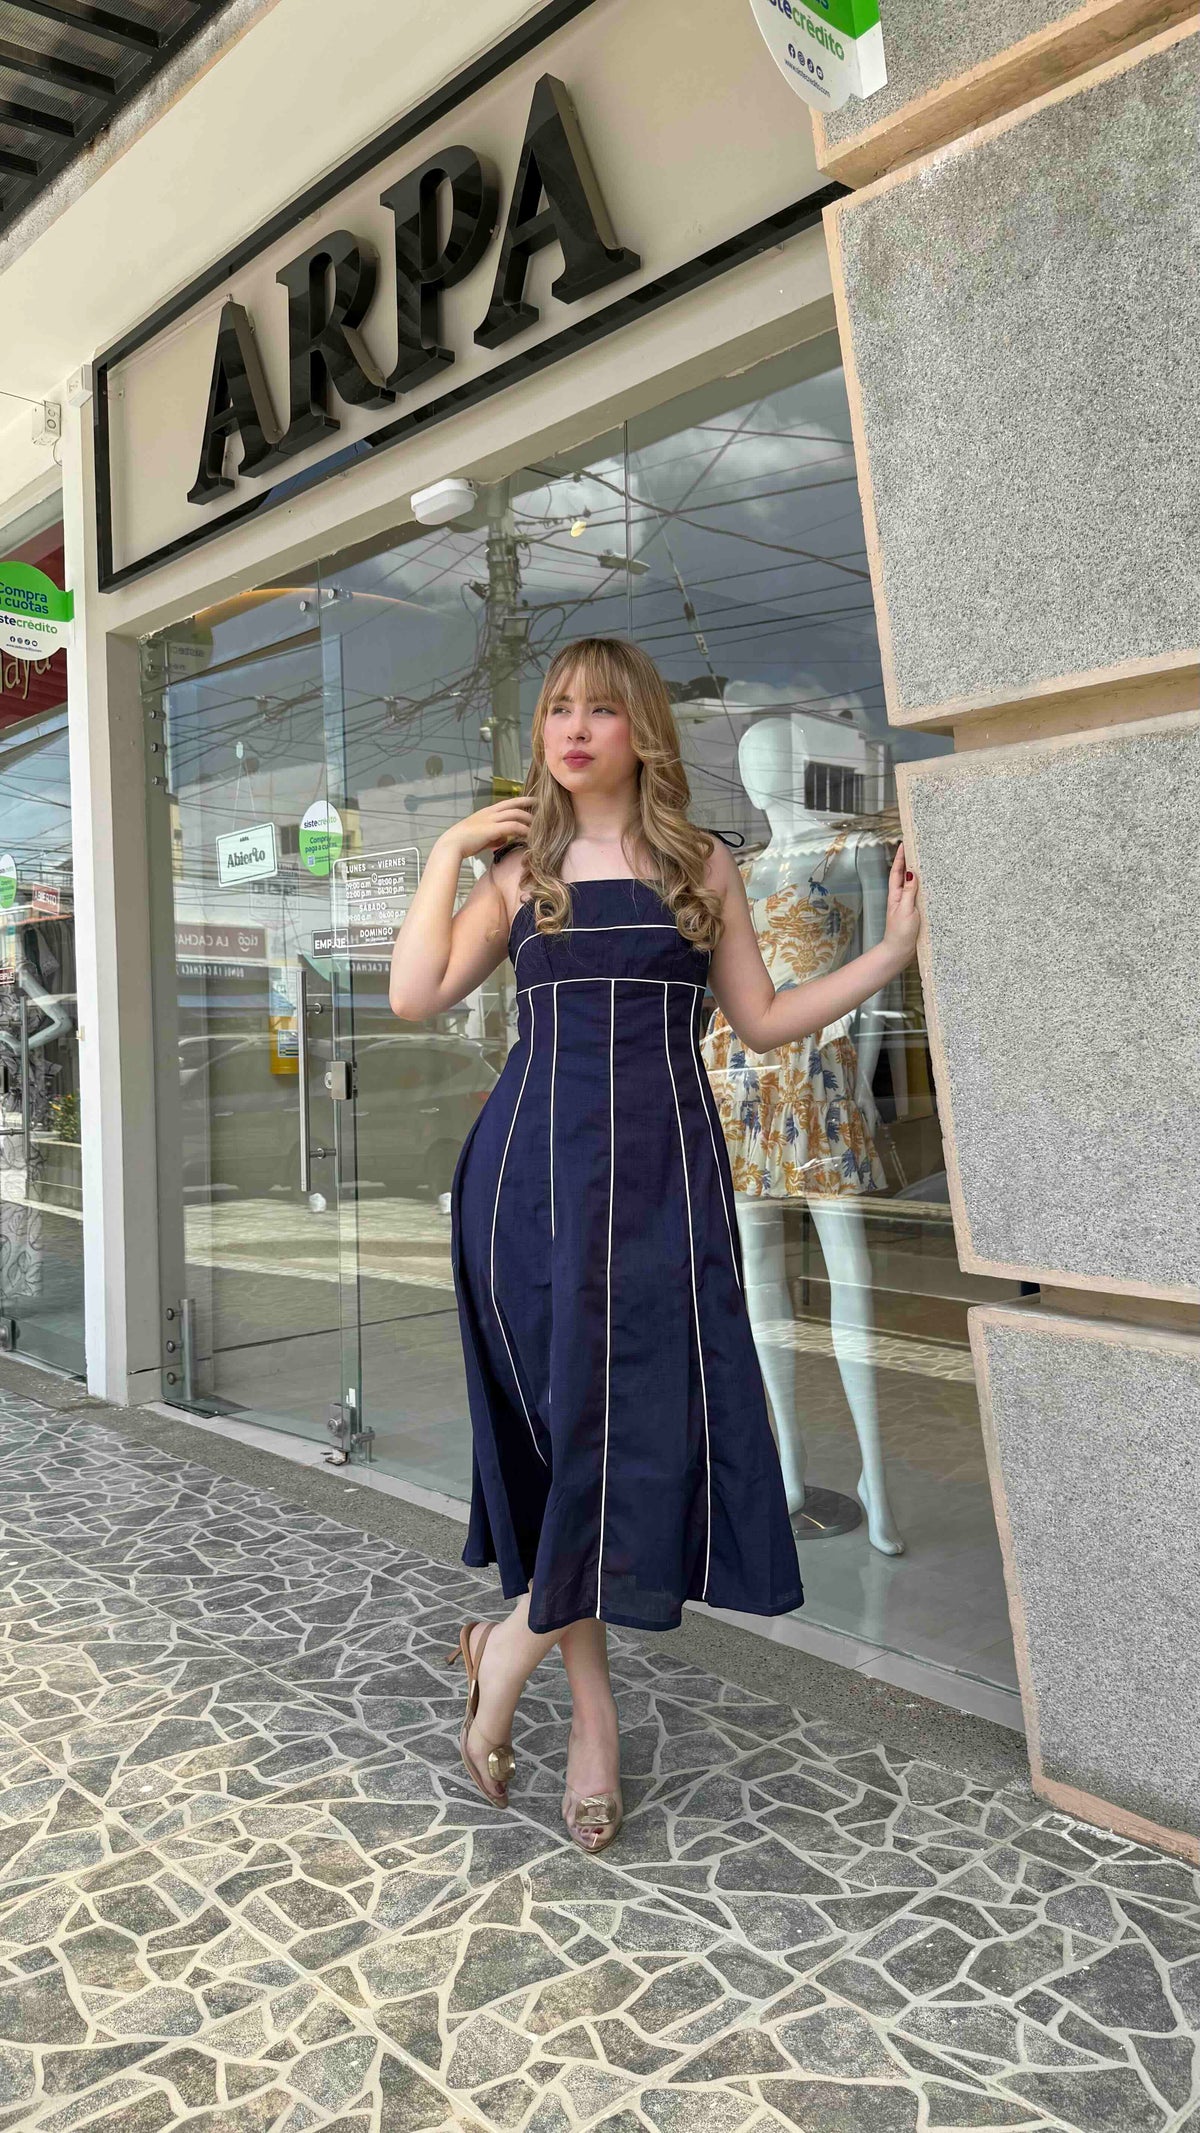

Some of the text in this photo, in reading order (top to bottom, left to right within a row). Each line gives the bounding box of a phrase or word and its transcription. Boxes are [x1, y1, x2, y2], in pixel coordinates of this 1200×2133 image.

[187, 73, 640, 505] ARPA
[0, 582, 47, 603] Compra
[5, 597, 49, 614] cuotas
[227, 847, 266, 868] Abierto
[346, 863, 366, 873] LUNES
[378, 858, 406, 869] VIERNES
[360, 927, 393, 938] DOMINGO
